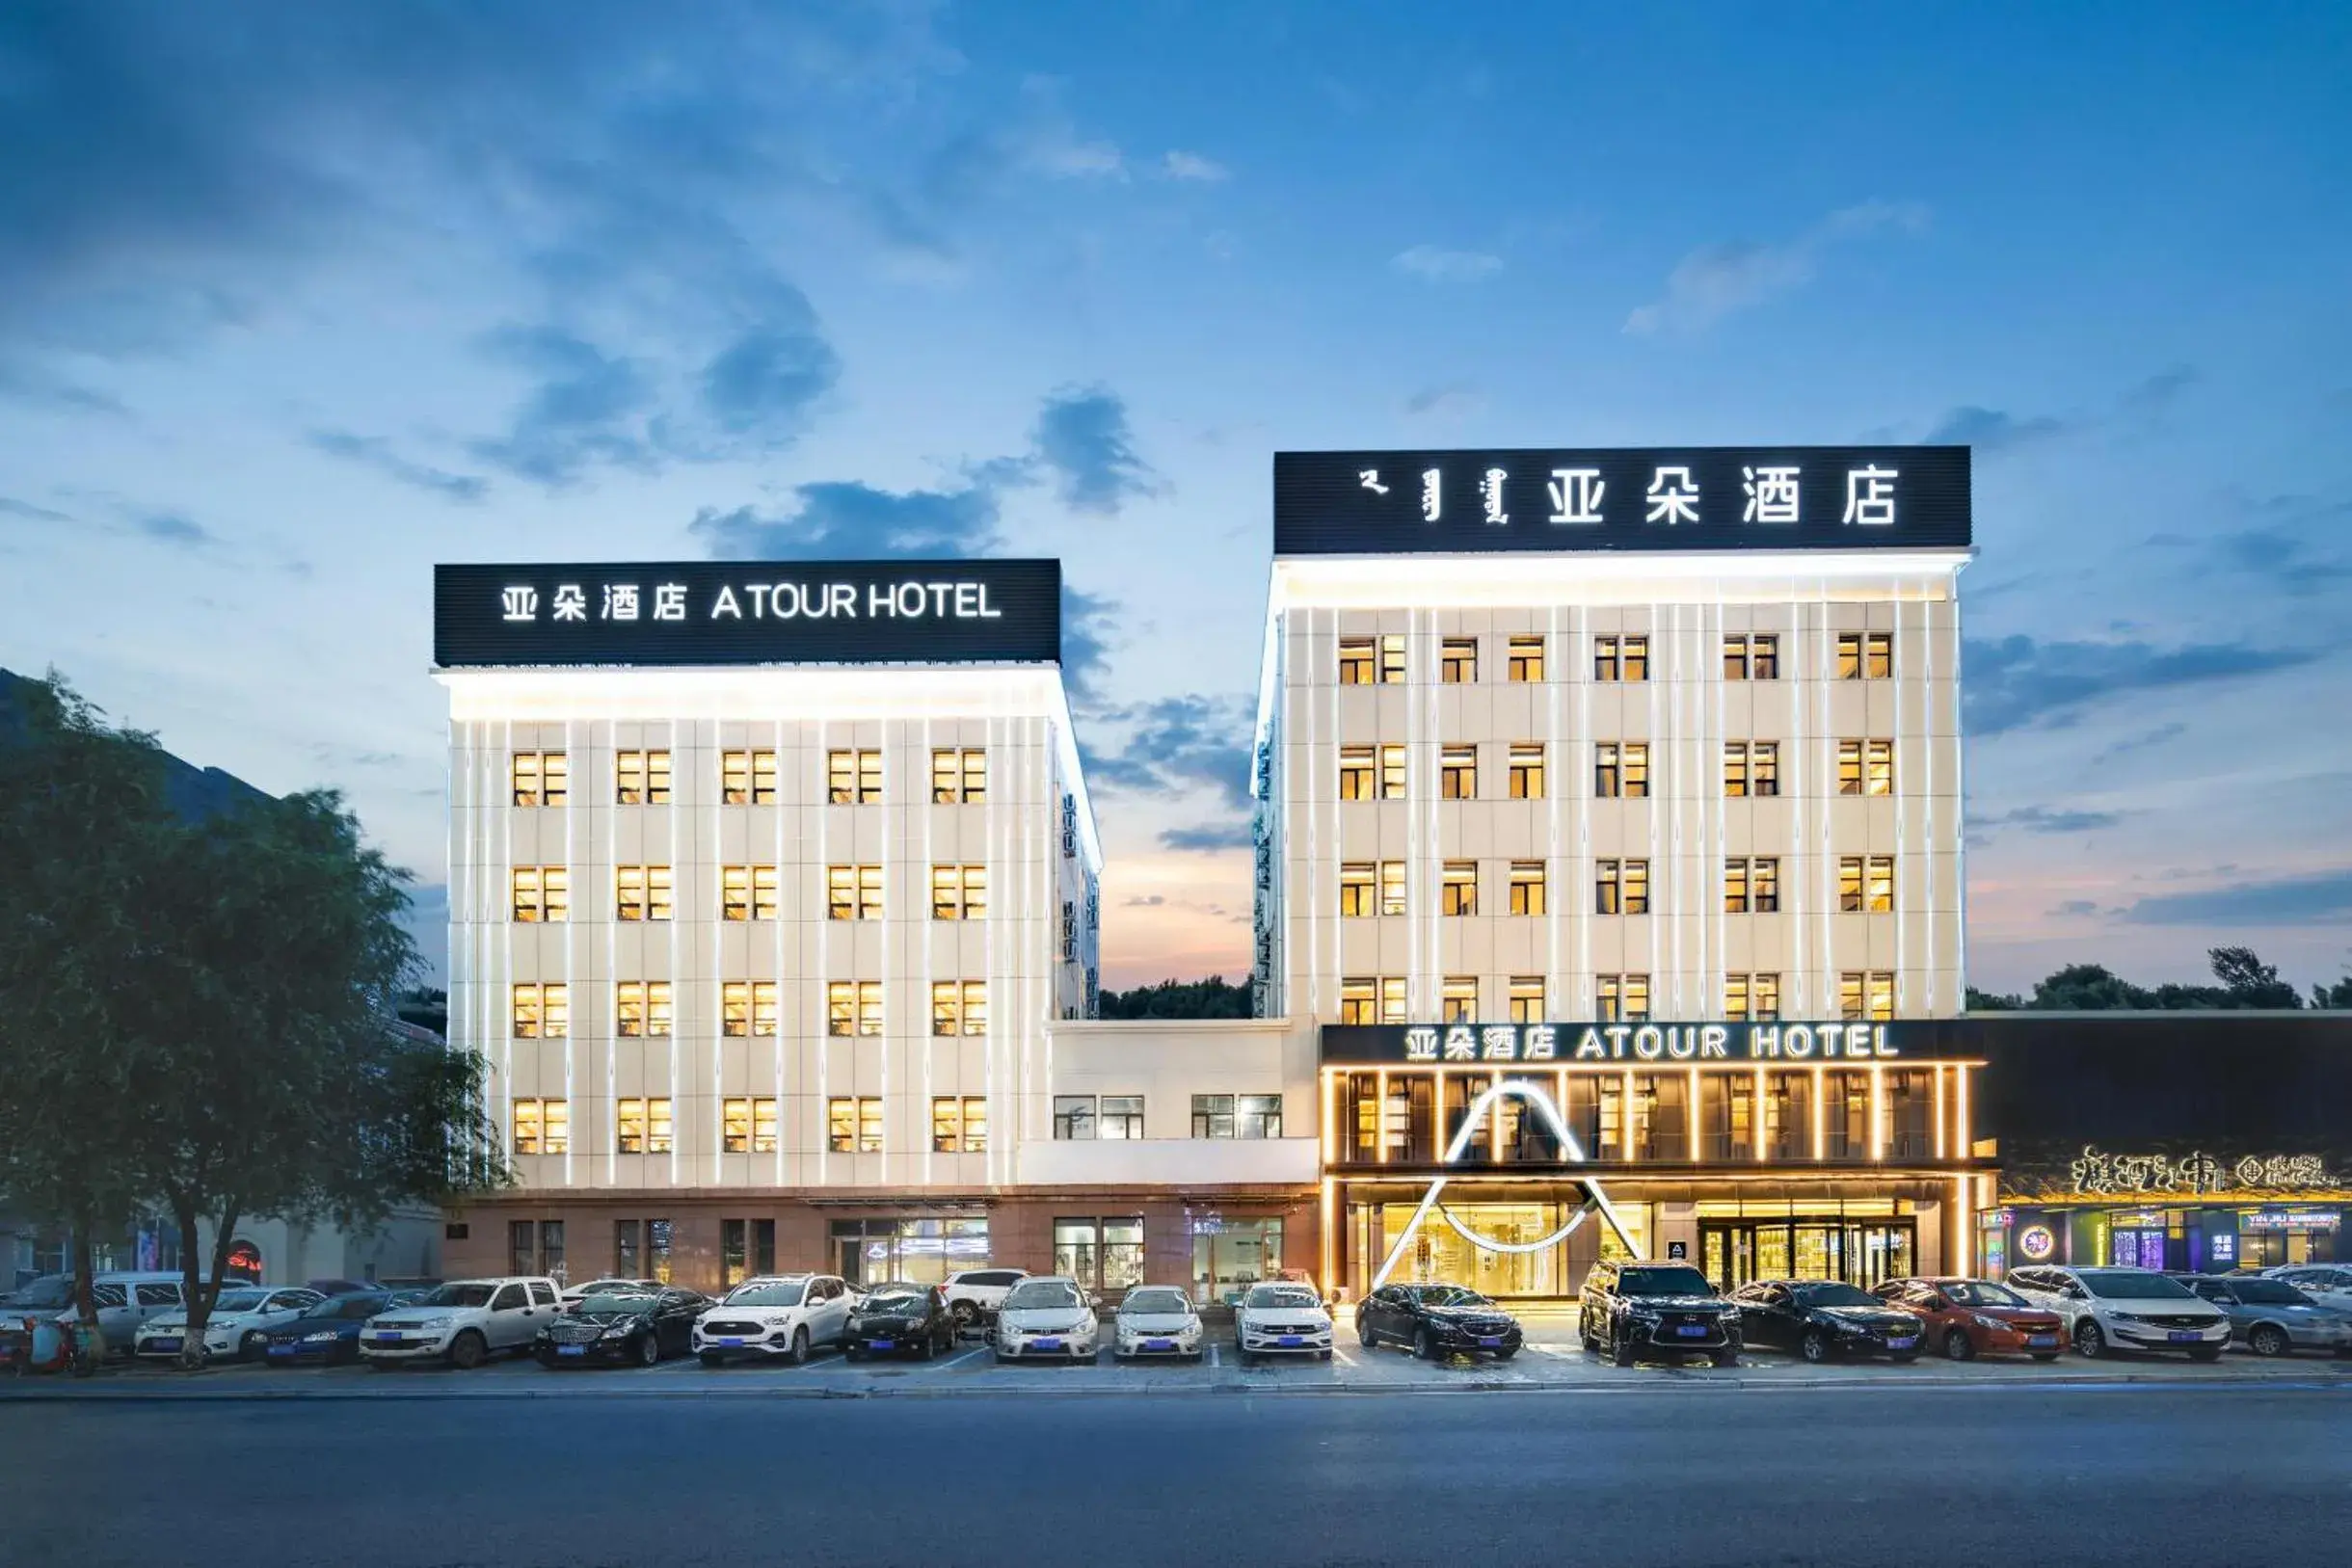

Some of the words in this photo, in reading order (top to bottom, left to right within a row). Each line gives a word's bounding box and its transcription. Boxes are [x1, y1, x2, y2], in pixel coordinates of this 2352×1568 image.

[1547, 464, 1898, 524] 亚朵酒店
[501, 583, 687, 622] 亚朵酒店
[710, 582, 857, 618] ATOUR
[869, 581, 1001, 618] HOTEL
[1405, 1027, 1557, 1059] 亚朵酒店
[1576, 1027, 1726, 1058] ATOUR
[1751, 1025, 1898, 1057] HOTEL
